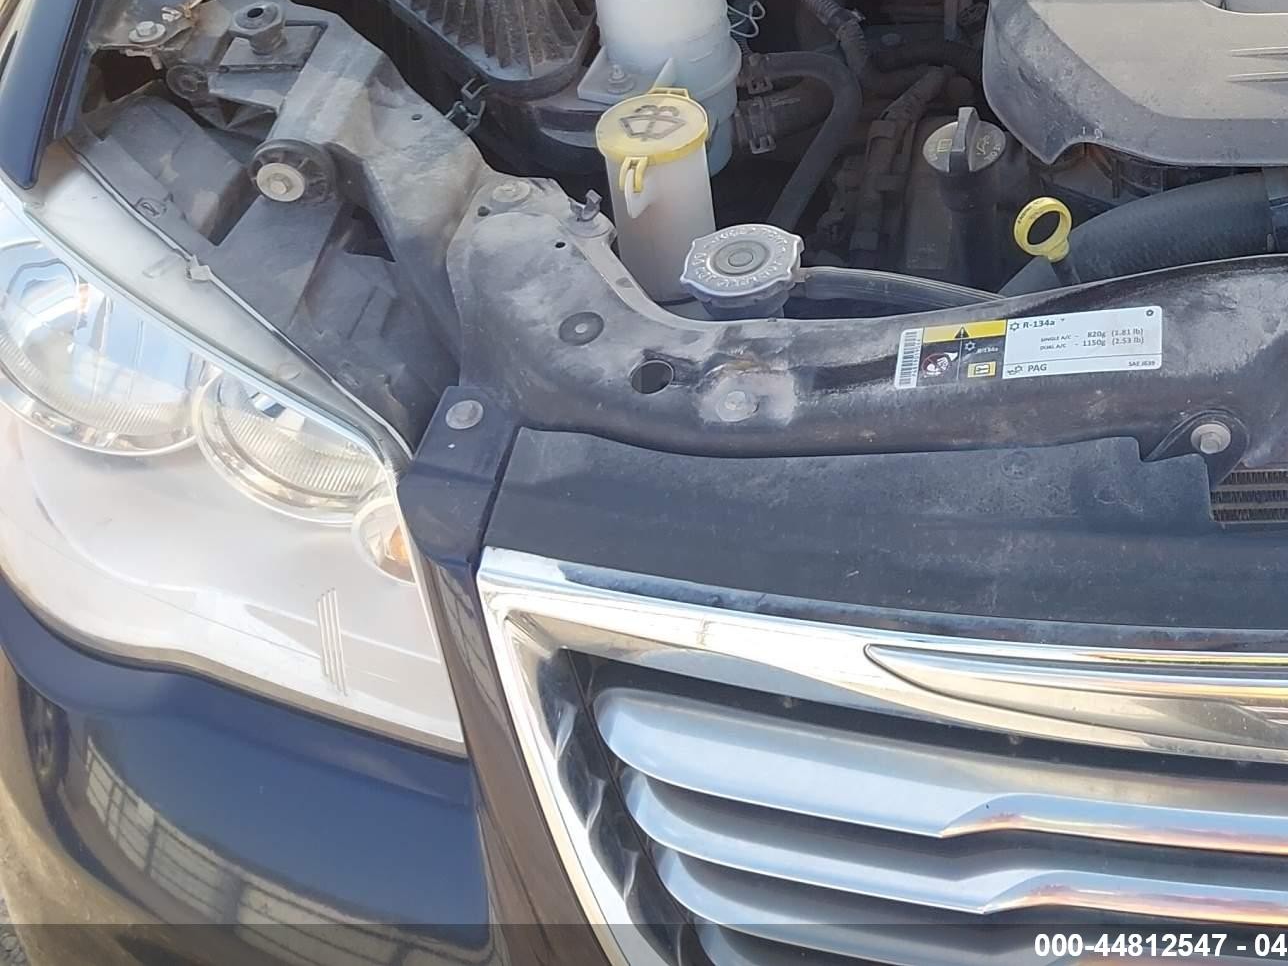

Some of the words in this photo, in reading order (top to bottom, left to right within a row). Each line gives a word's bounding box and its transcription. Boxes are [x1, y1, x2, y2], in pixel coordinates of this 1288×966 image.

[1023, 319, 1055, 329] R-134a
[1087, 331, 1106, 339] 820g
[1083, 339, 1106, 347] 1150g
[1027, 363, 1048, 372] PAG
